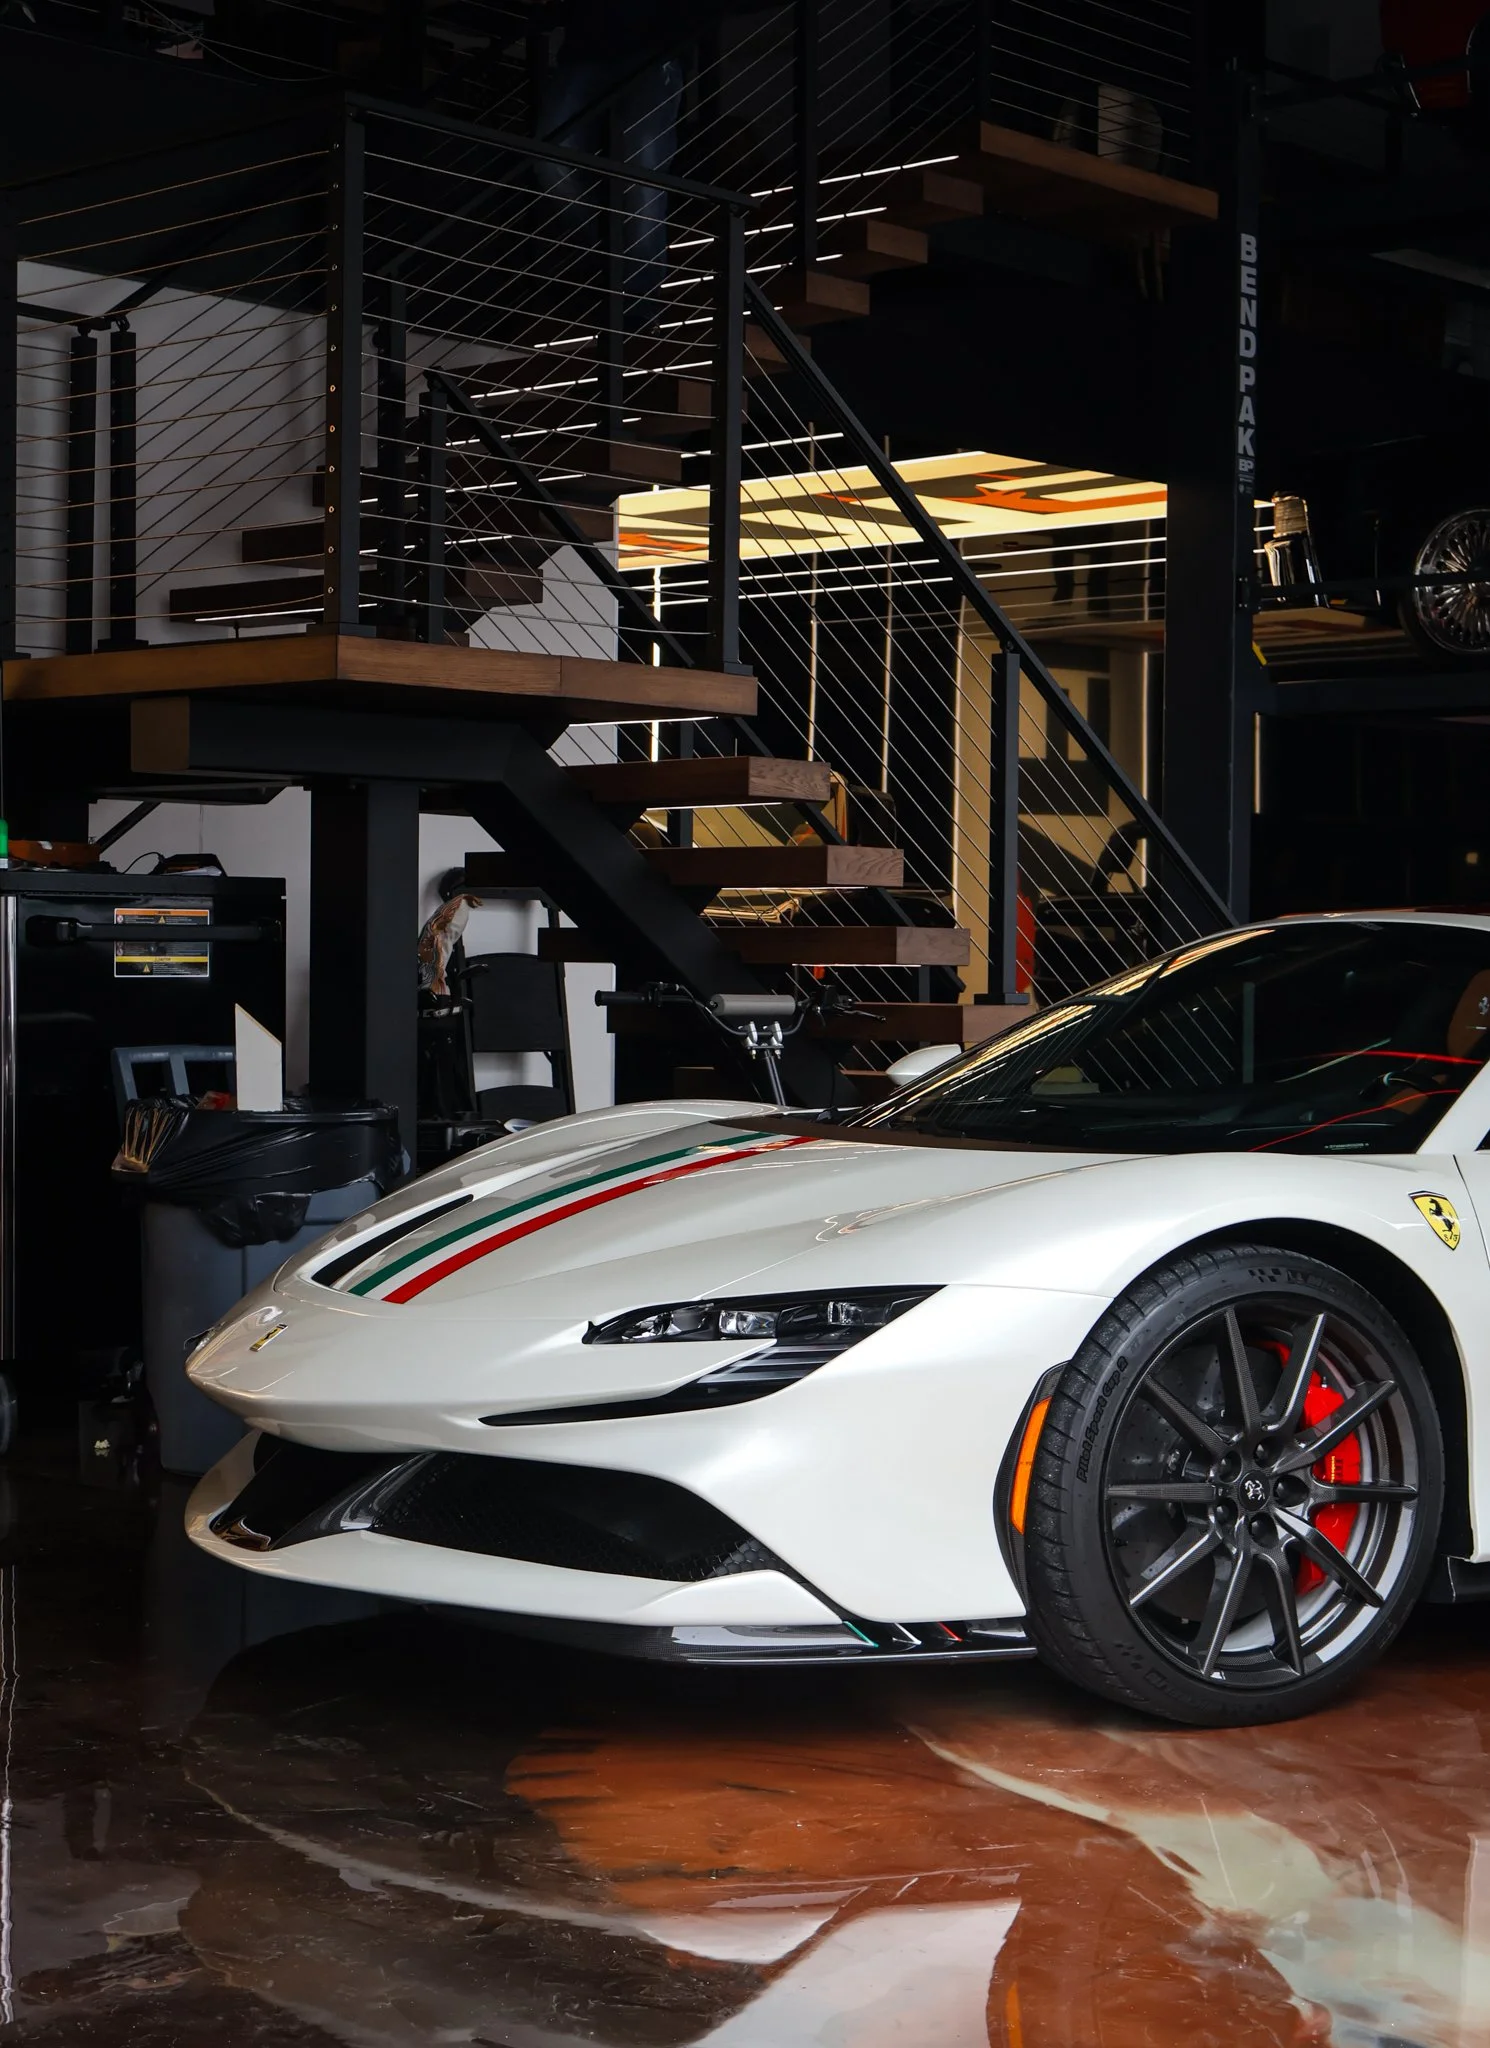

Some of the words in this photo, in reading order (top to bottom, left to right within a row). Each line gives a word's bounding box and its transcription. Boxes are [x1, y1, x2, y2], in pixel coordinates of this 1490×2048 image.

[1238, 233, 1258, 457] BENDPAK
[1076, 1440, 1093, 1483] Pilot
[1085, 1395, 1107, 1443] Sport
[1102, 1370, 1121, 1397] Cup
[1116, 1356, 1128, 1372] 2
